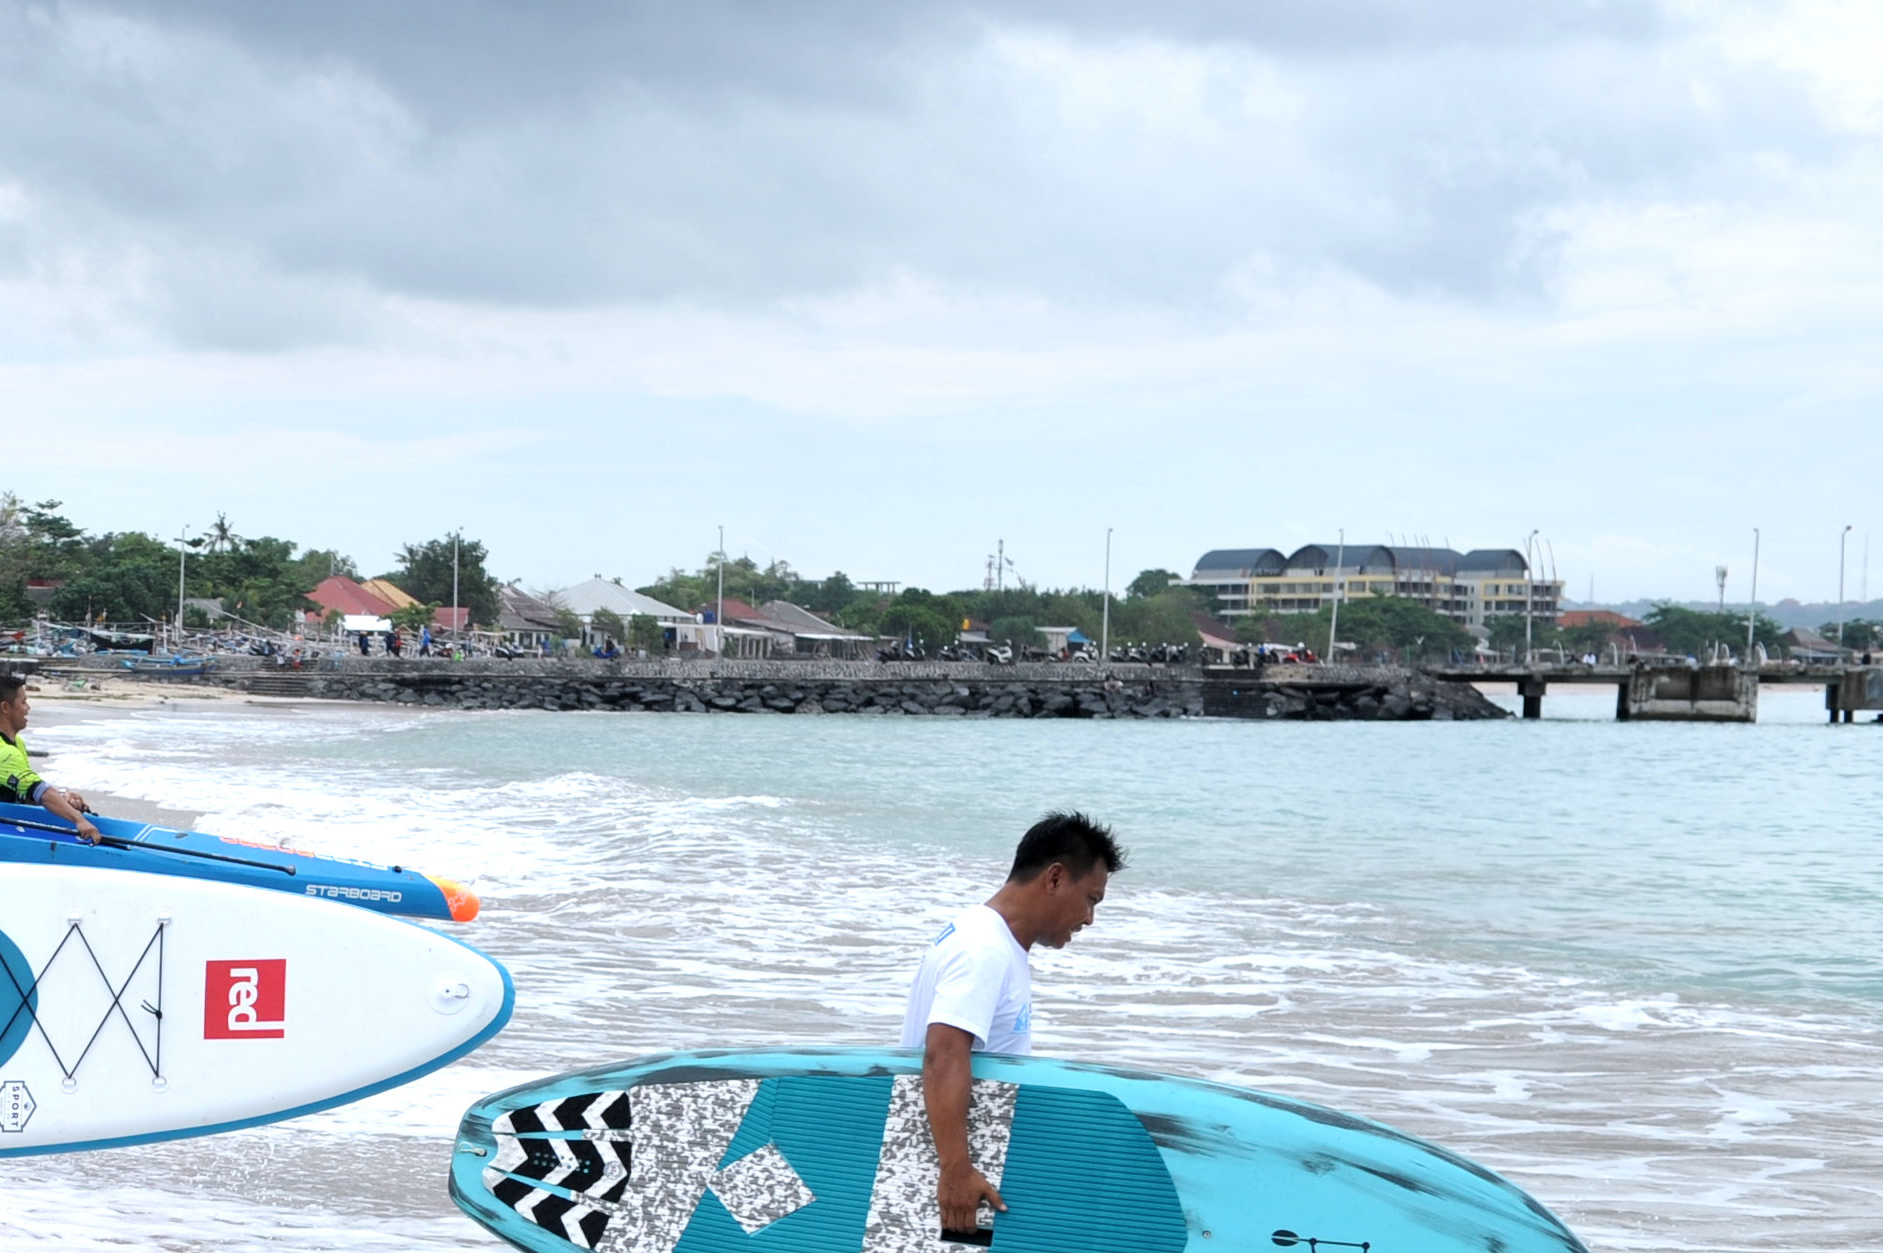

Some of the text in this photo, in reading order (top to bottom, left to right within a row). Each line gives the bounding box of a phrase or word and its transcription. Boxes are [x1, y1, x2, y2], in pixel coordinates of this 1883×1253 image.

[305, 884, 402, 903] STARBOARD
[228, 967, 285, 1031] red
[10, 1085, 20, 1127] SPORT
